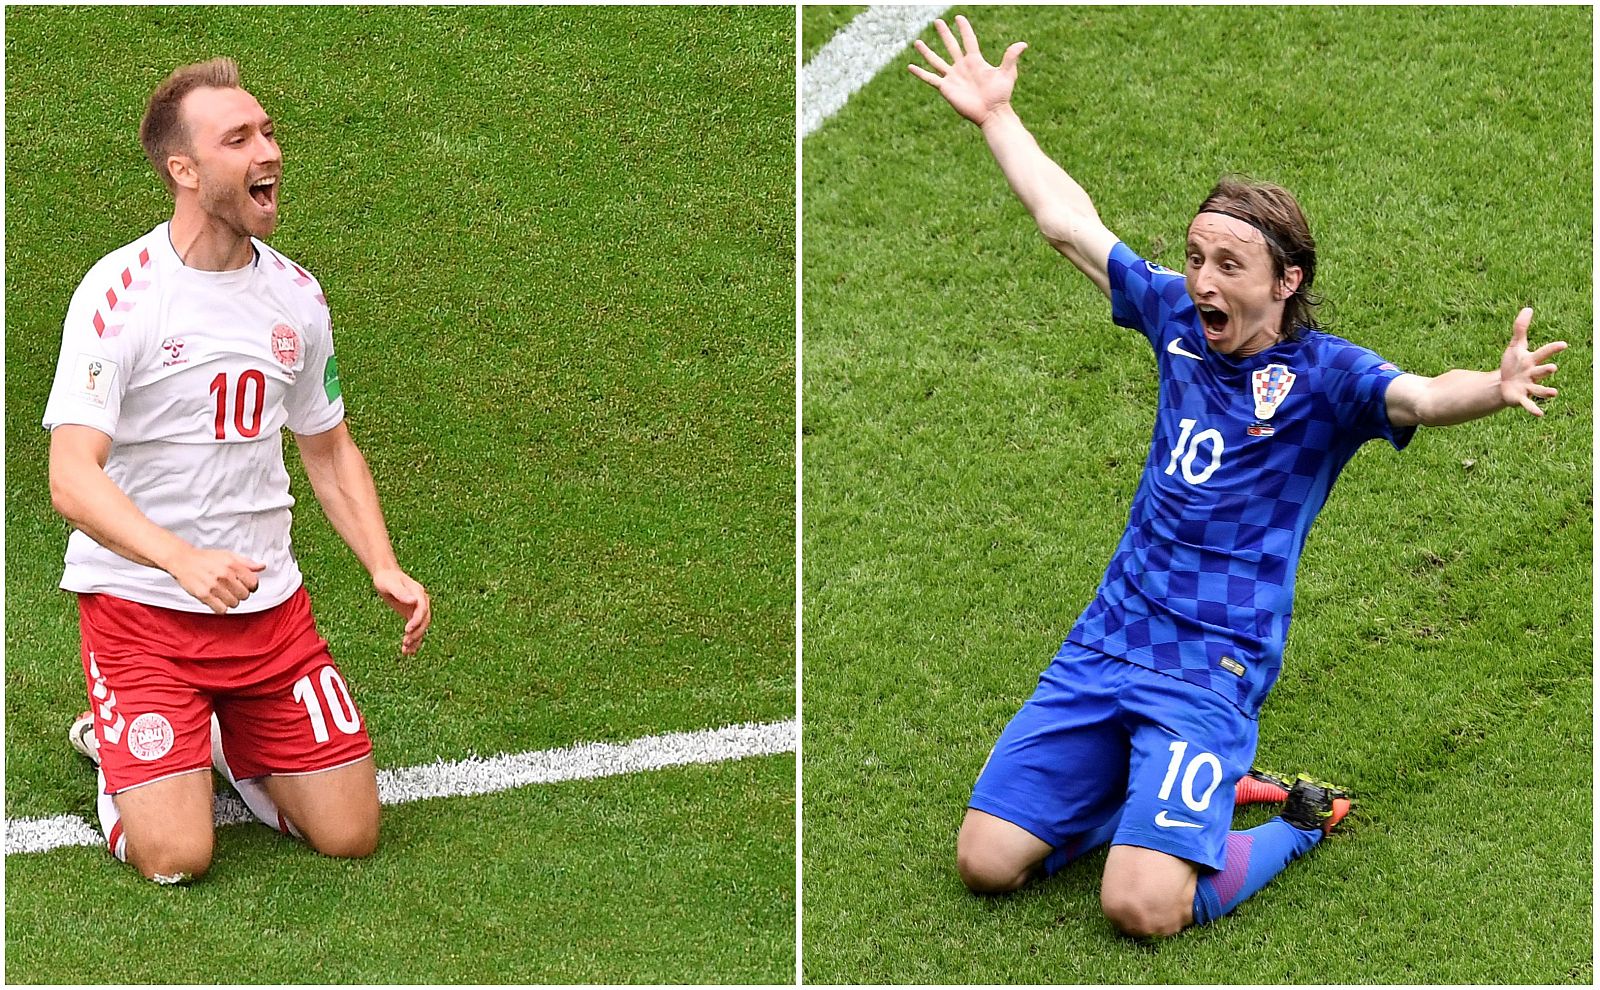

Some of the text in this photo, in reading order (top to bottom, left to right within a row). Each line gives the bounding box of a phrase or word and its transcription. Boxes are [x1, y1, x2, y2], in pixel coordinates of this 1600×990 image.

[209, 369, 266, 440] 10
[1164, 418, 1225, 485] 10
[293, 665, 361, 744] 10
[1157, 741, 1223, 812] 10
